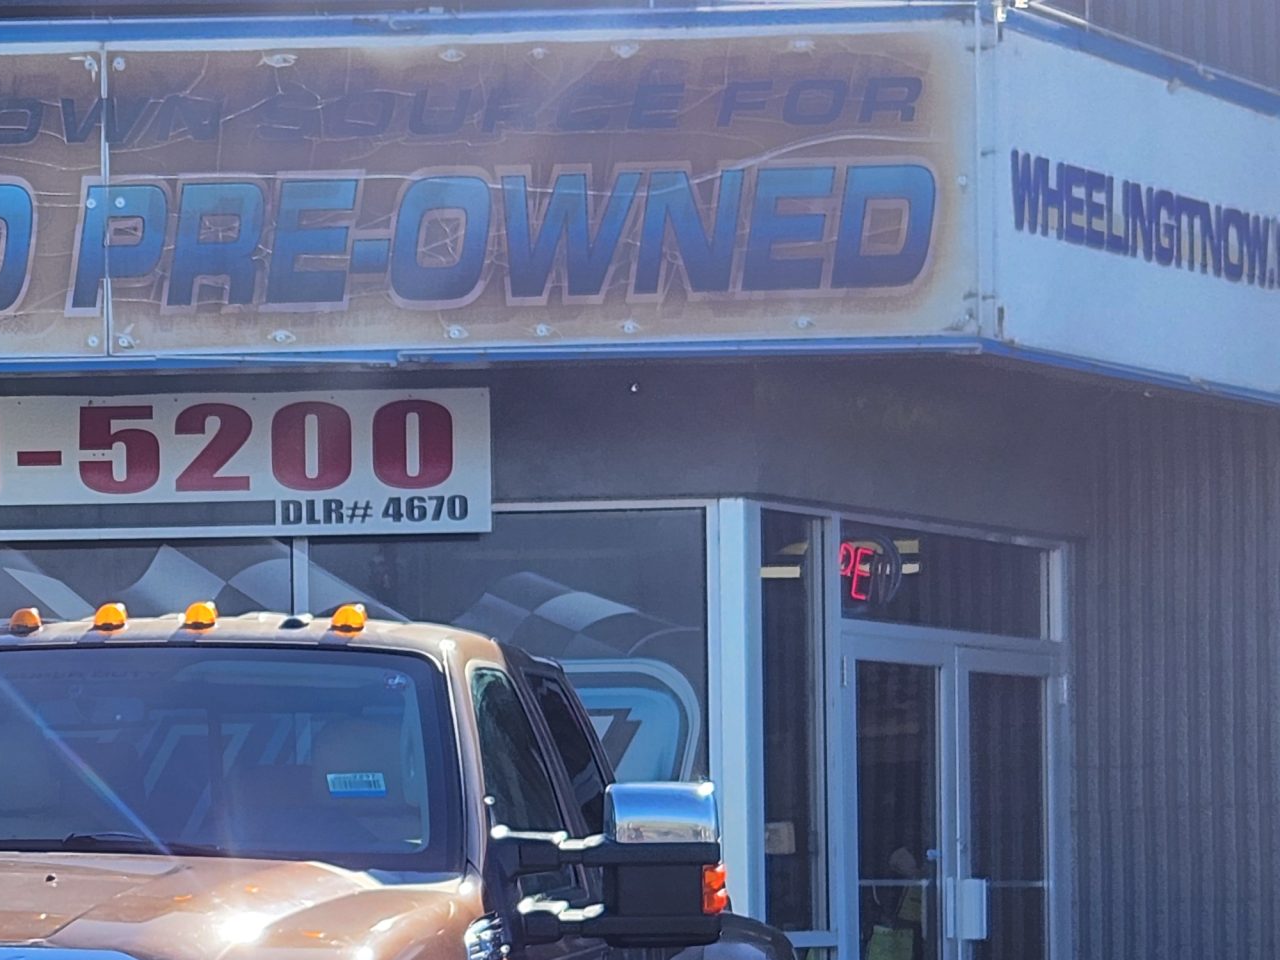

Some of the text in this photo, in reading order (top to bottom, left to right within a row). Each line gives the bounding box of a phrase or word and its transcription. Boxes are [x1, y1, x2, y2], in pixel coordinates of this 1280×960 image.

[257, 82, 686, 142] SOURCE
[716, 77, 923, 127] FOR
[65, 161, 937, 316] PRE-OWNED
[1011, 148, 1280, 289] WHEELINGITNOW.
[281, 494, 468, 525] DLR# 4670
